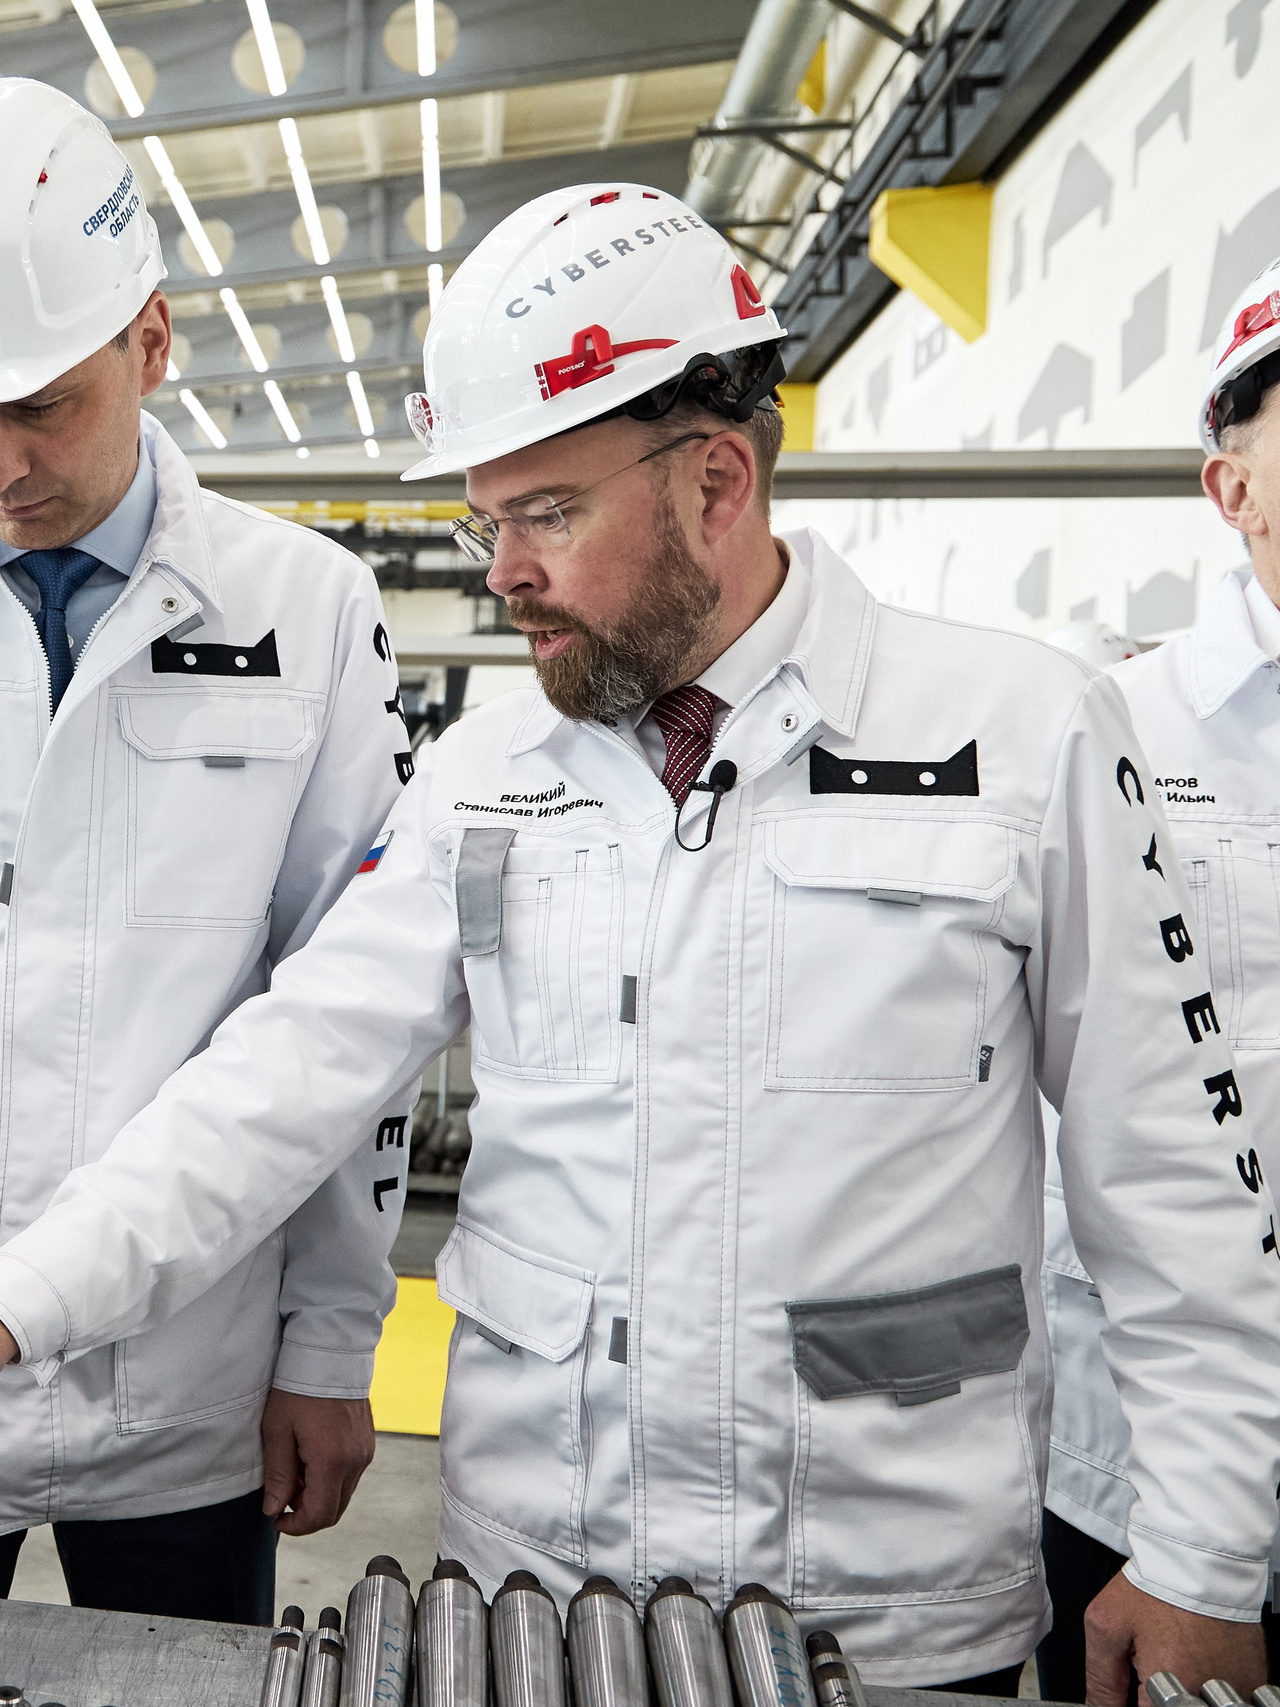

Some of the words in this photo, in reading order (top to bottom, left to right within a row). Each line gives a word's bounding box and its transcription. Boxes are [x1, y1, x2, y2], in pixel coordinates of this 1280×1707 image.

[110, 193, 140, 238] ОБЛАСТЬ
[505, 215, 705, 319] CYBERSTEE
[500, 781, 566, 804] ВЕЛИКИЙ
[1167, 792, 1216, 803] Ильич
[454, 801, 534, 817] Станислав
[537, 798, 604, 818] Игоревич
